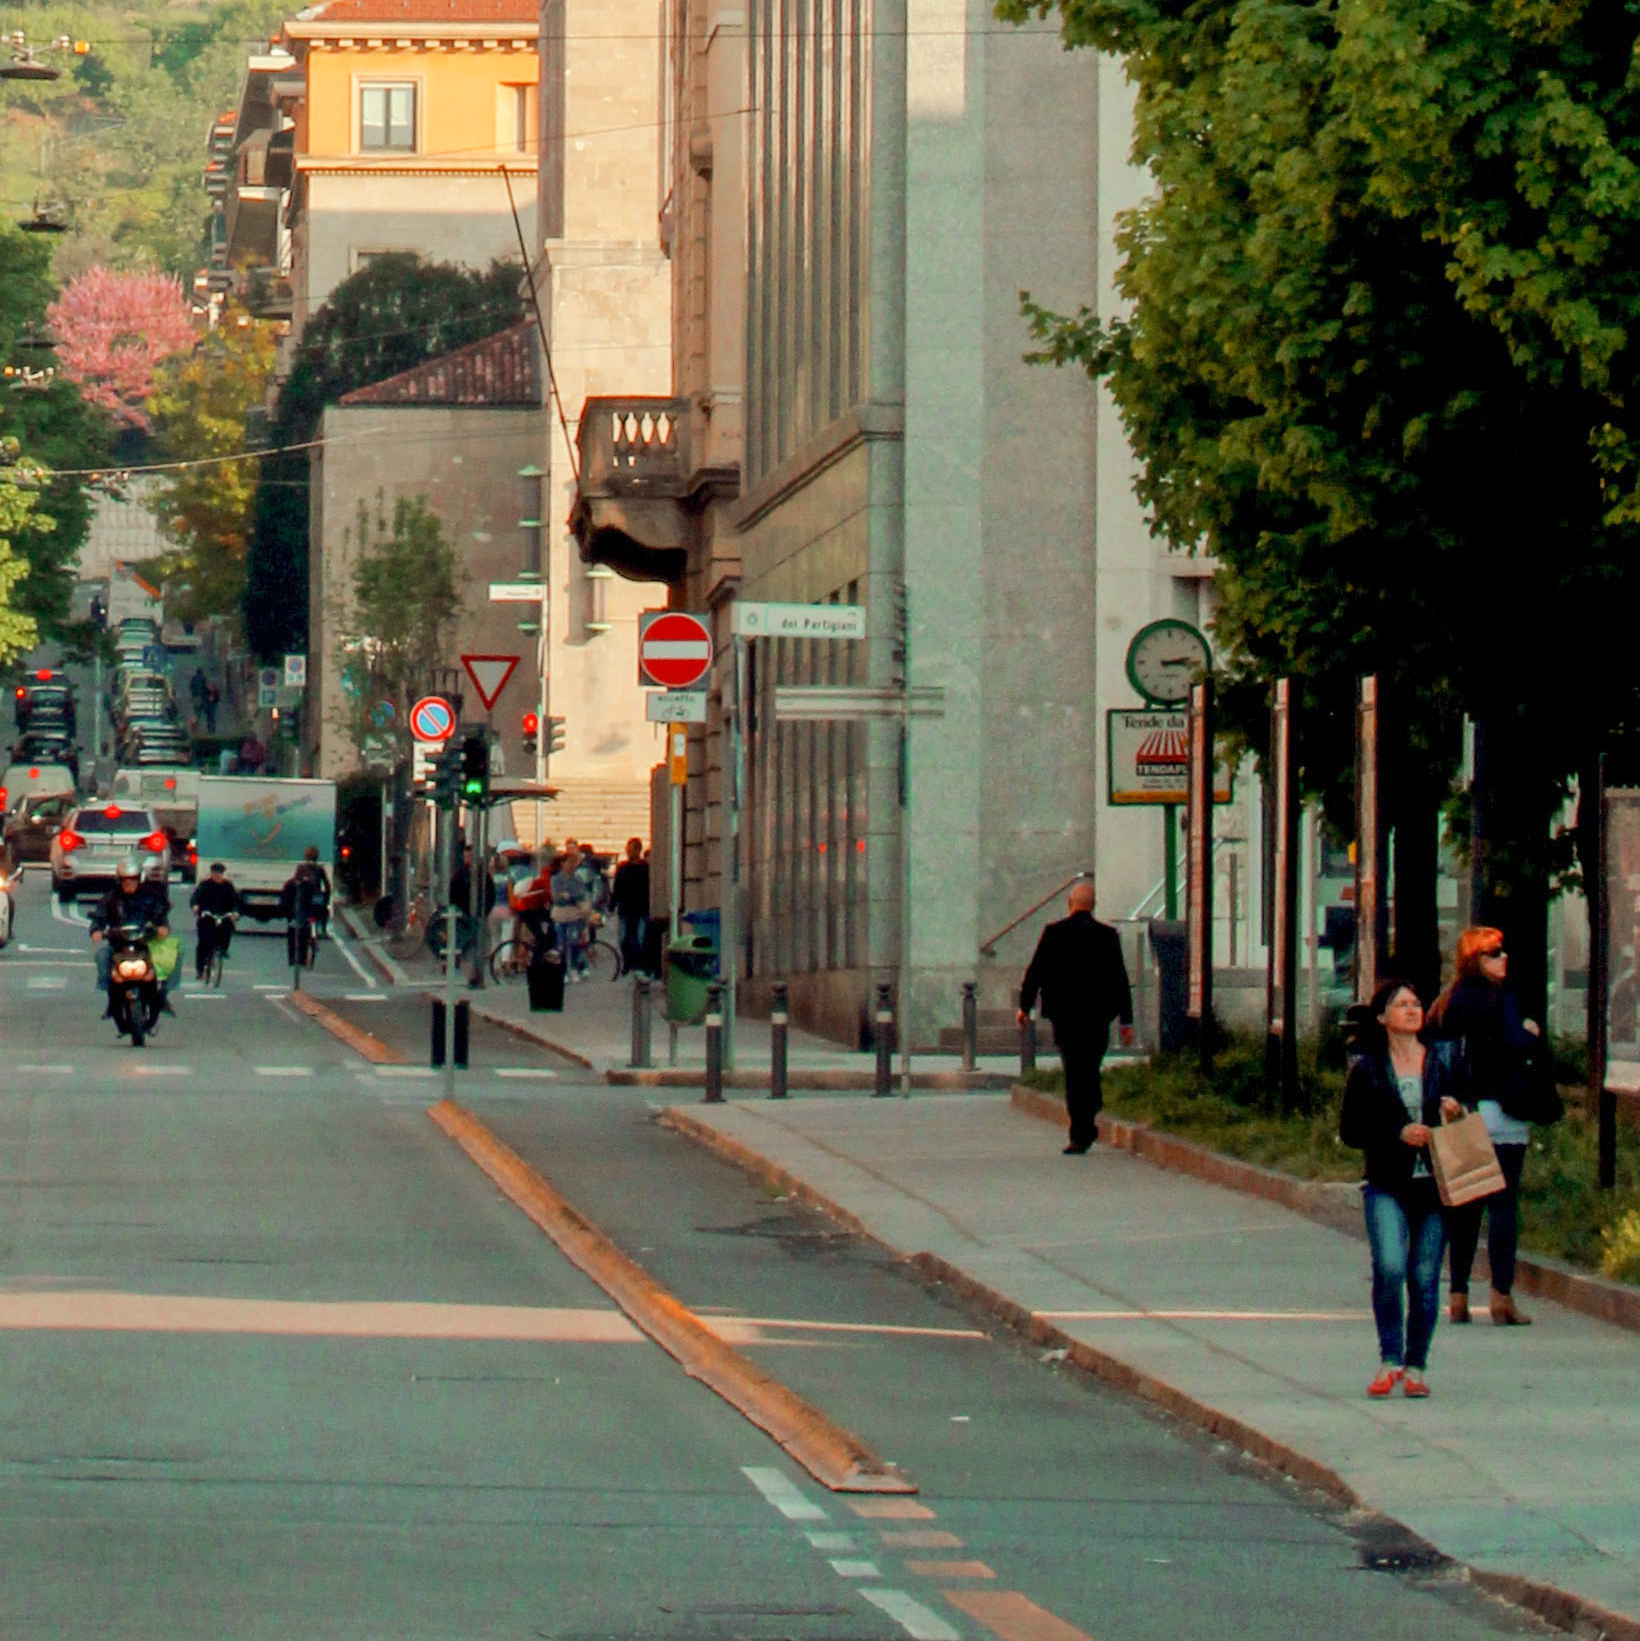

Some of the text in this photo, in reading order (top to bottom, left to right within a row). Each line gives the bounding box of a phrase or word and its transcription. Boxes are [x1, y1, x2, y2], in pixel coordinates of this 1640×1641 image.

[804, 618, 857, 632] Partigiani
[1122, 715, 1185, 728] Tende da
